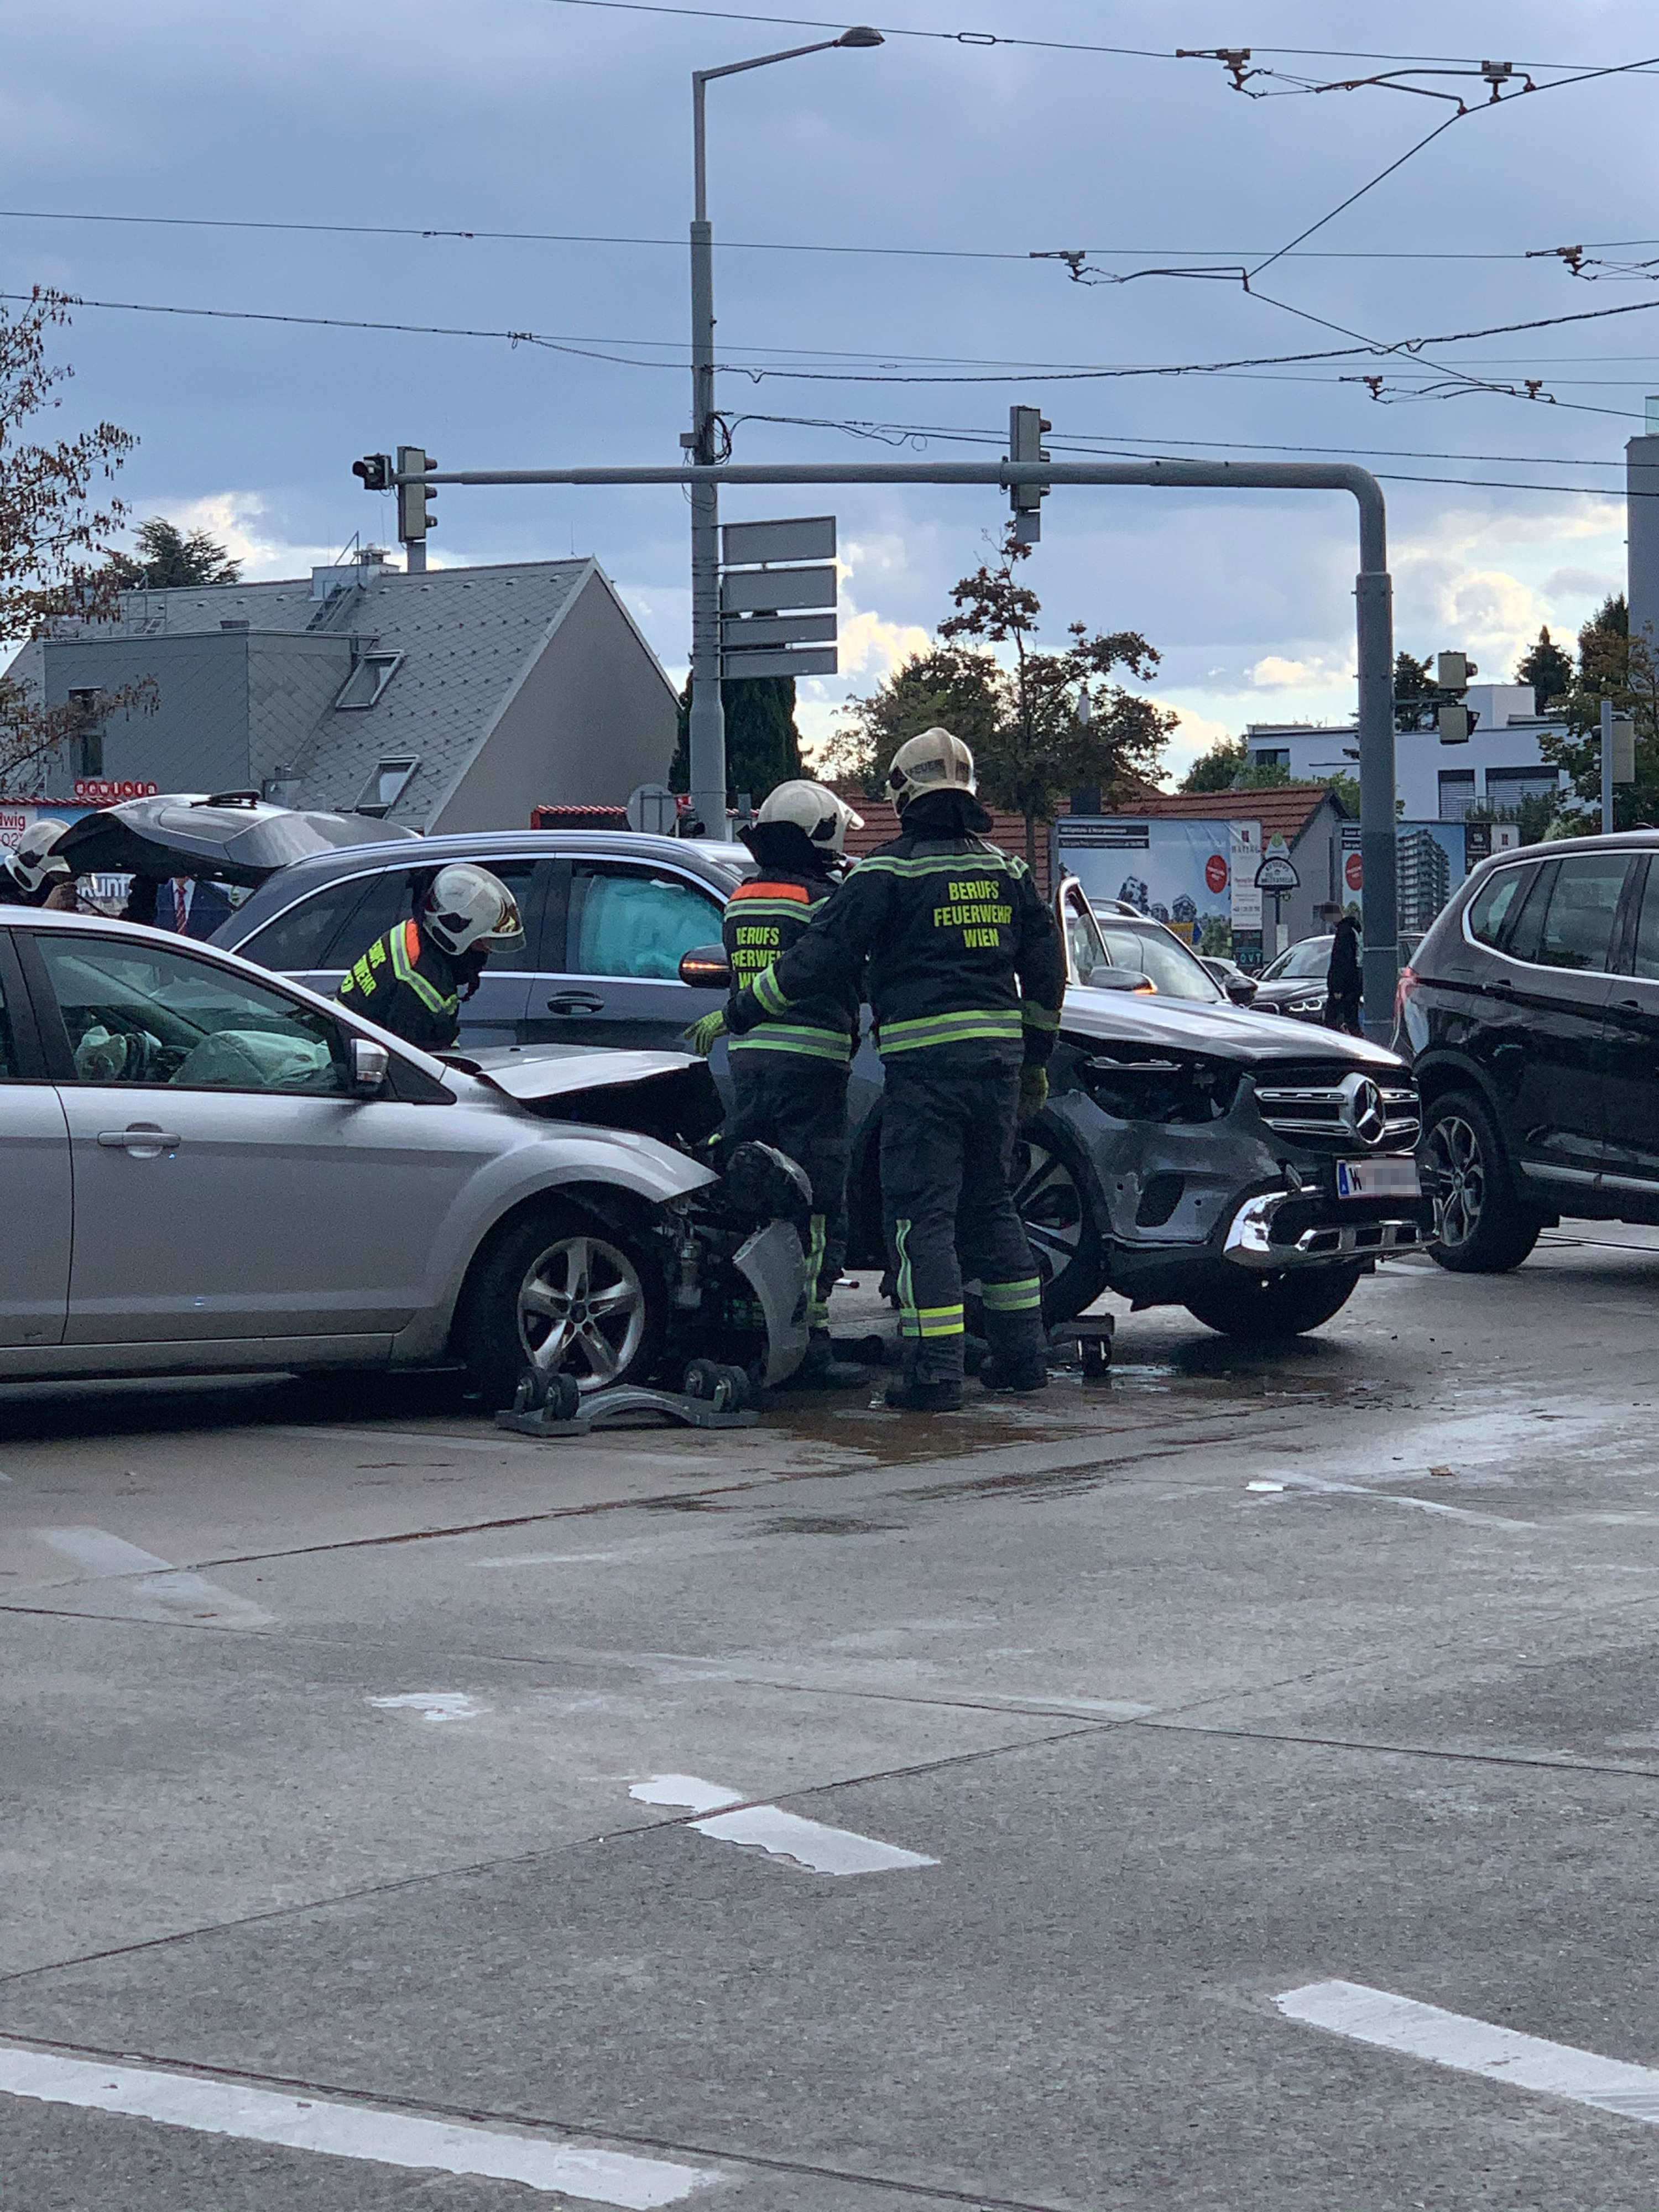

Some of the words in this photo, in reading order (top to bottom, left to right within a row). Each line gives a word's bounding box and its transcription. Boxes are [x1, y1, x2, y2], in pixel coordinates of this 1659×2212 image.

[2, 833, 23, 847] 02
[948, 880, 999, 900] BERUFS
[933, 904, 1013, 927] FEUERWEHR
[963, 928, 999, 948] WIEN
